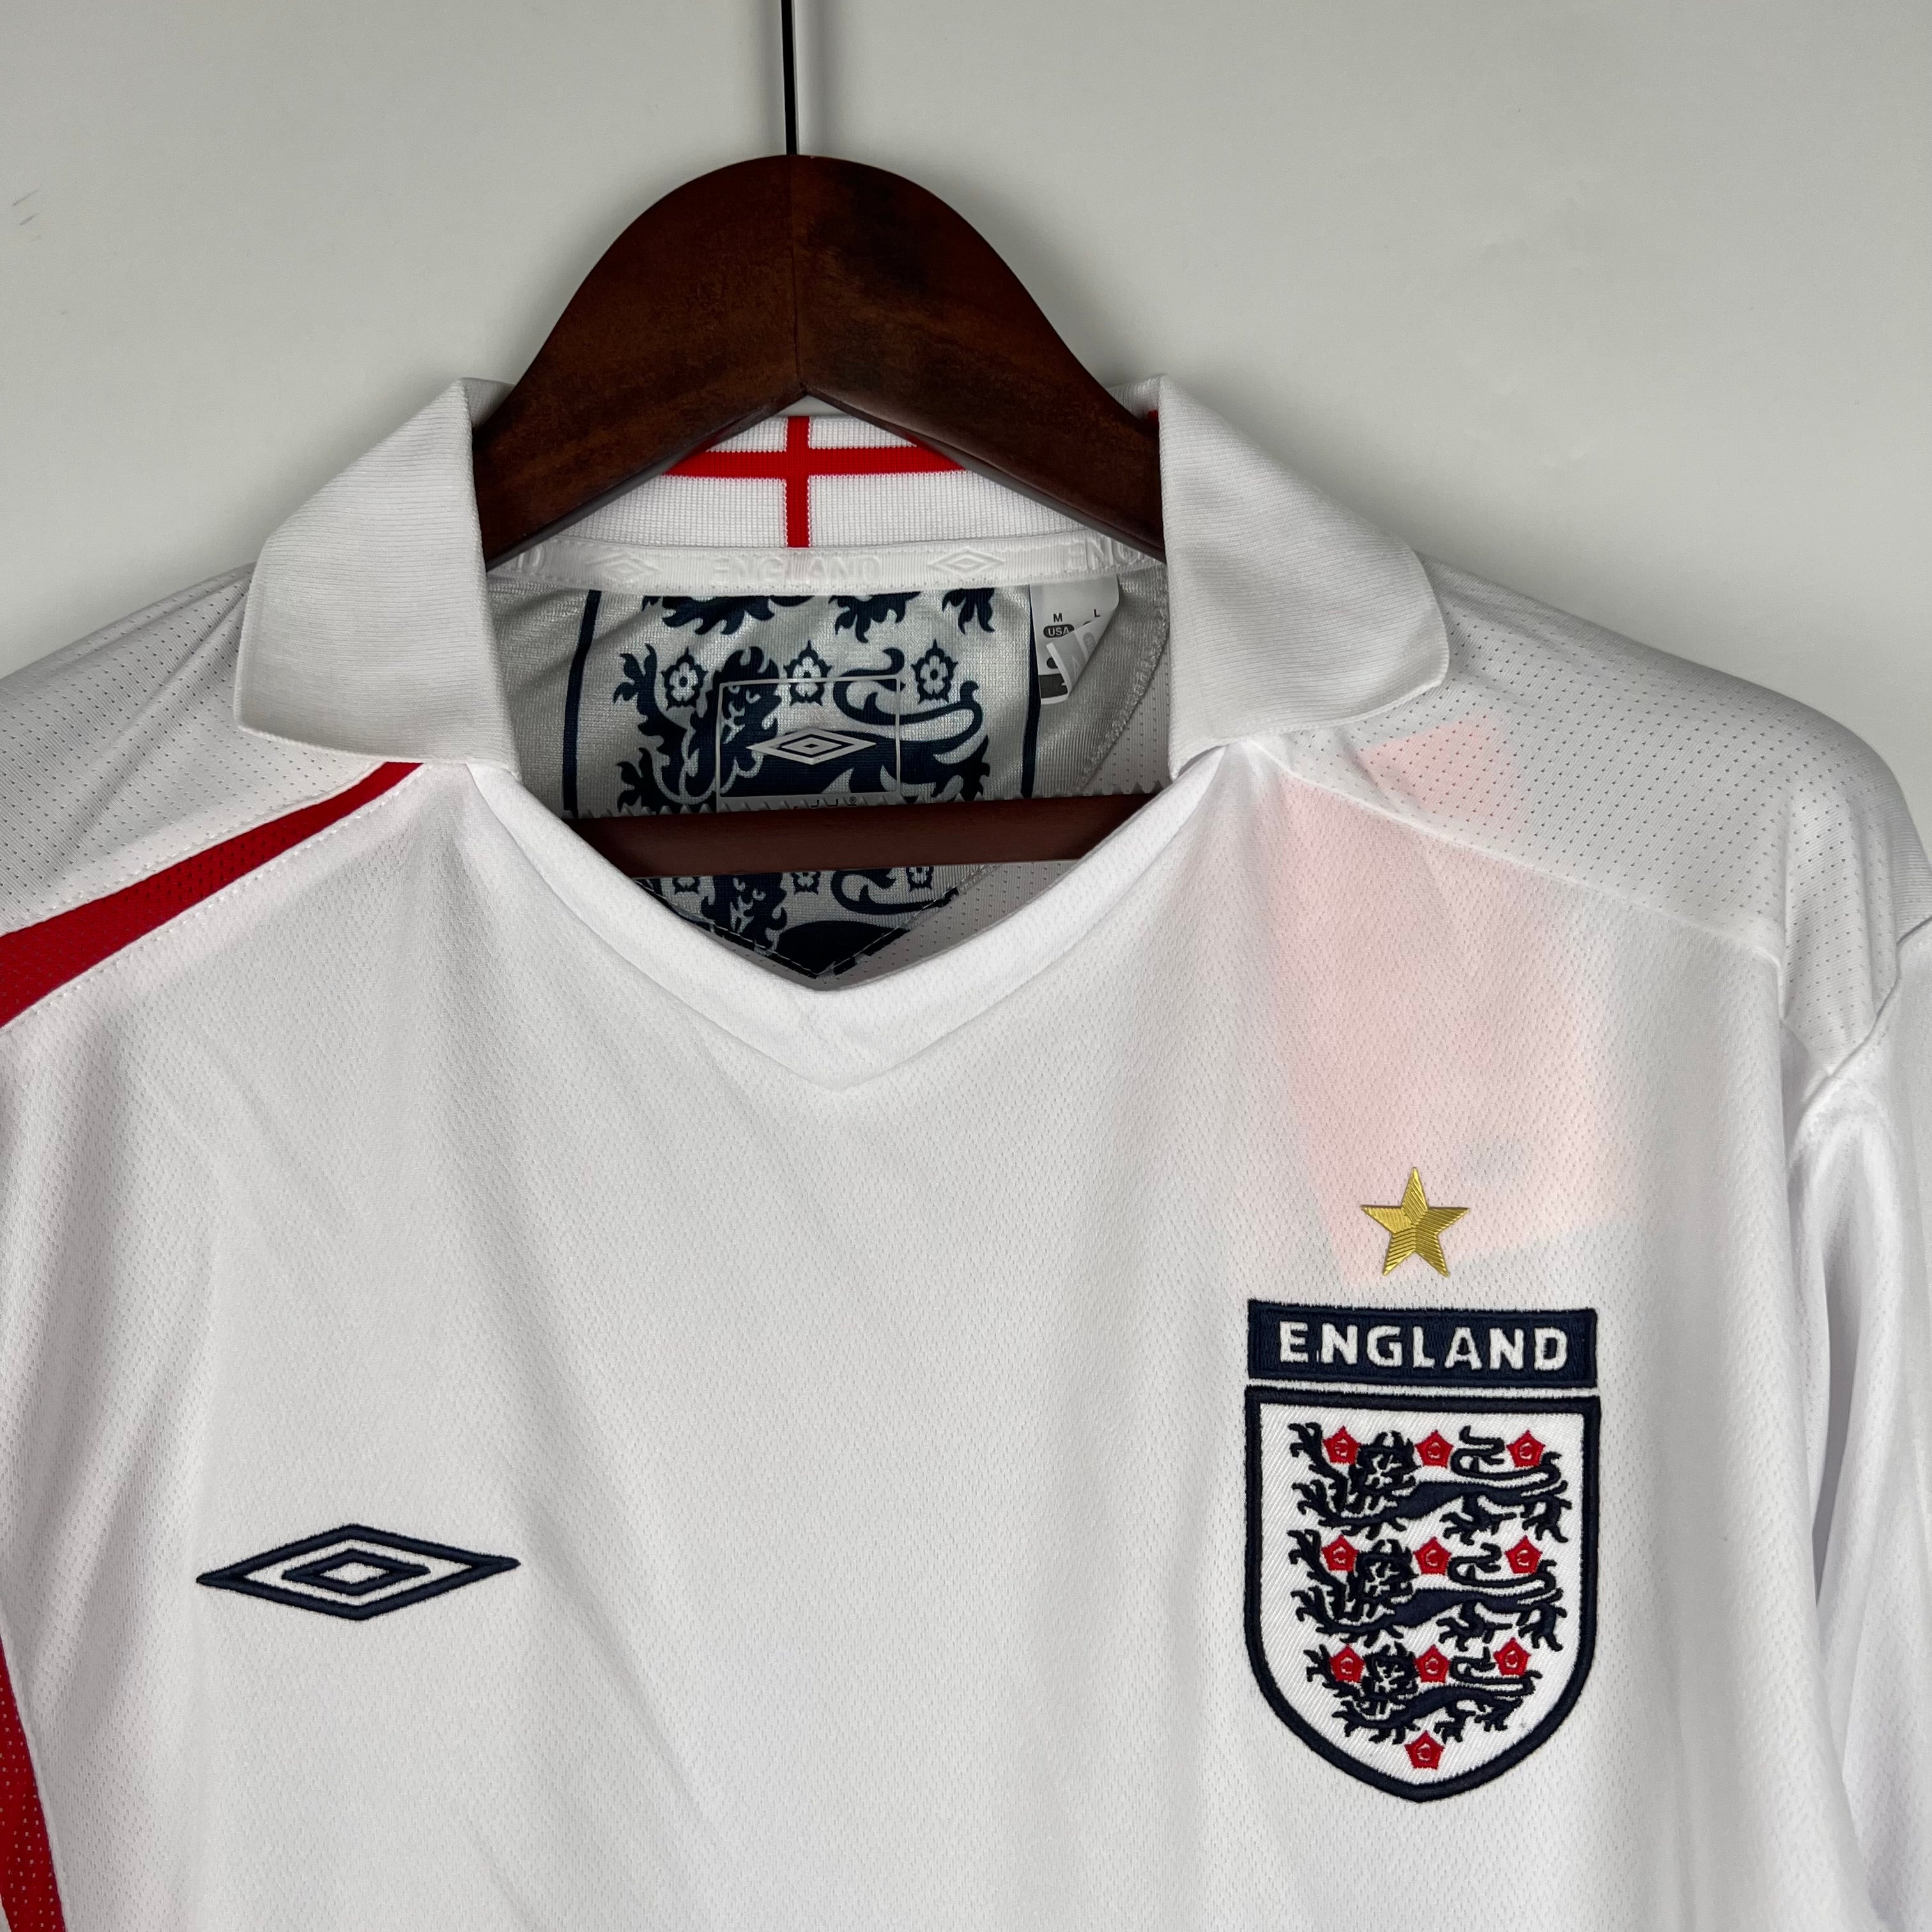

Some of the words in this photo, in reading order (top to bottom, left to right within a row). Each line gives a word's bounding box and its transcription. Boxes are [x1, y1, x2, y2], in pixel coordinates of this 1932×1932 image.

[710, 555, 880, 584] ENGLAND
[1053, 613, 1062, 622] M
[1094, 609, 1101, 618] L
[1048, 626, 1070, 636] USA
[1279, 1321, 1568, 1371] ENGLAND
